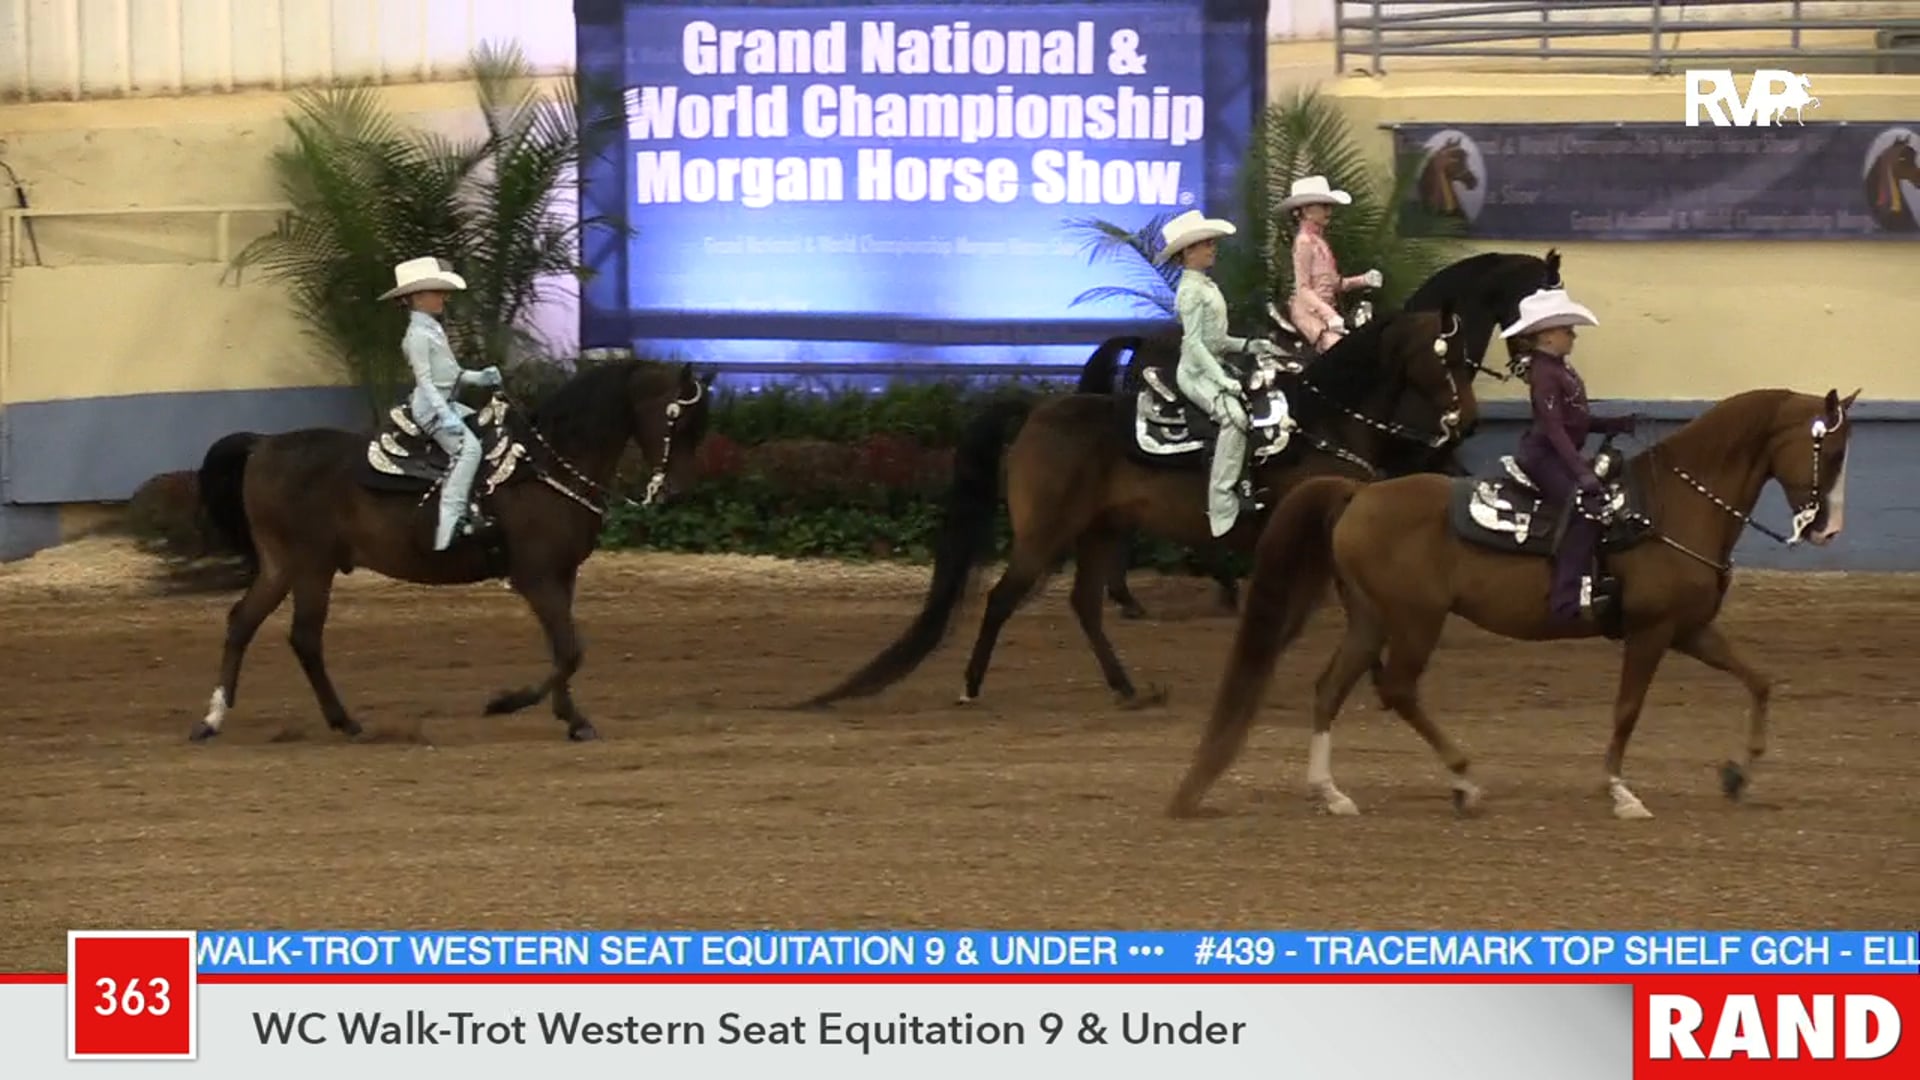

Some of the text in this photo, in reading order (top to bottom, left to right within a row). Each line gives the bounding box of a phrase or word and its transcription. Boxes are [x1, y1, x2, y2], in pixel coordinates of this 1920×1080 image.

[683, 21, 1147, 75] Grand National &
[624, 84, 1204, 146] World Championship
[636, 150, 844, 209] Morgan
[857, 148, 1020, 204] Horse
